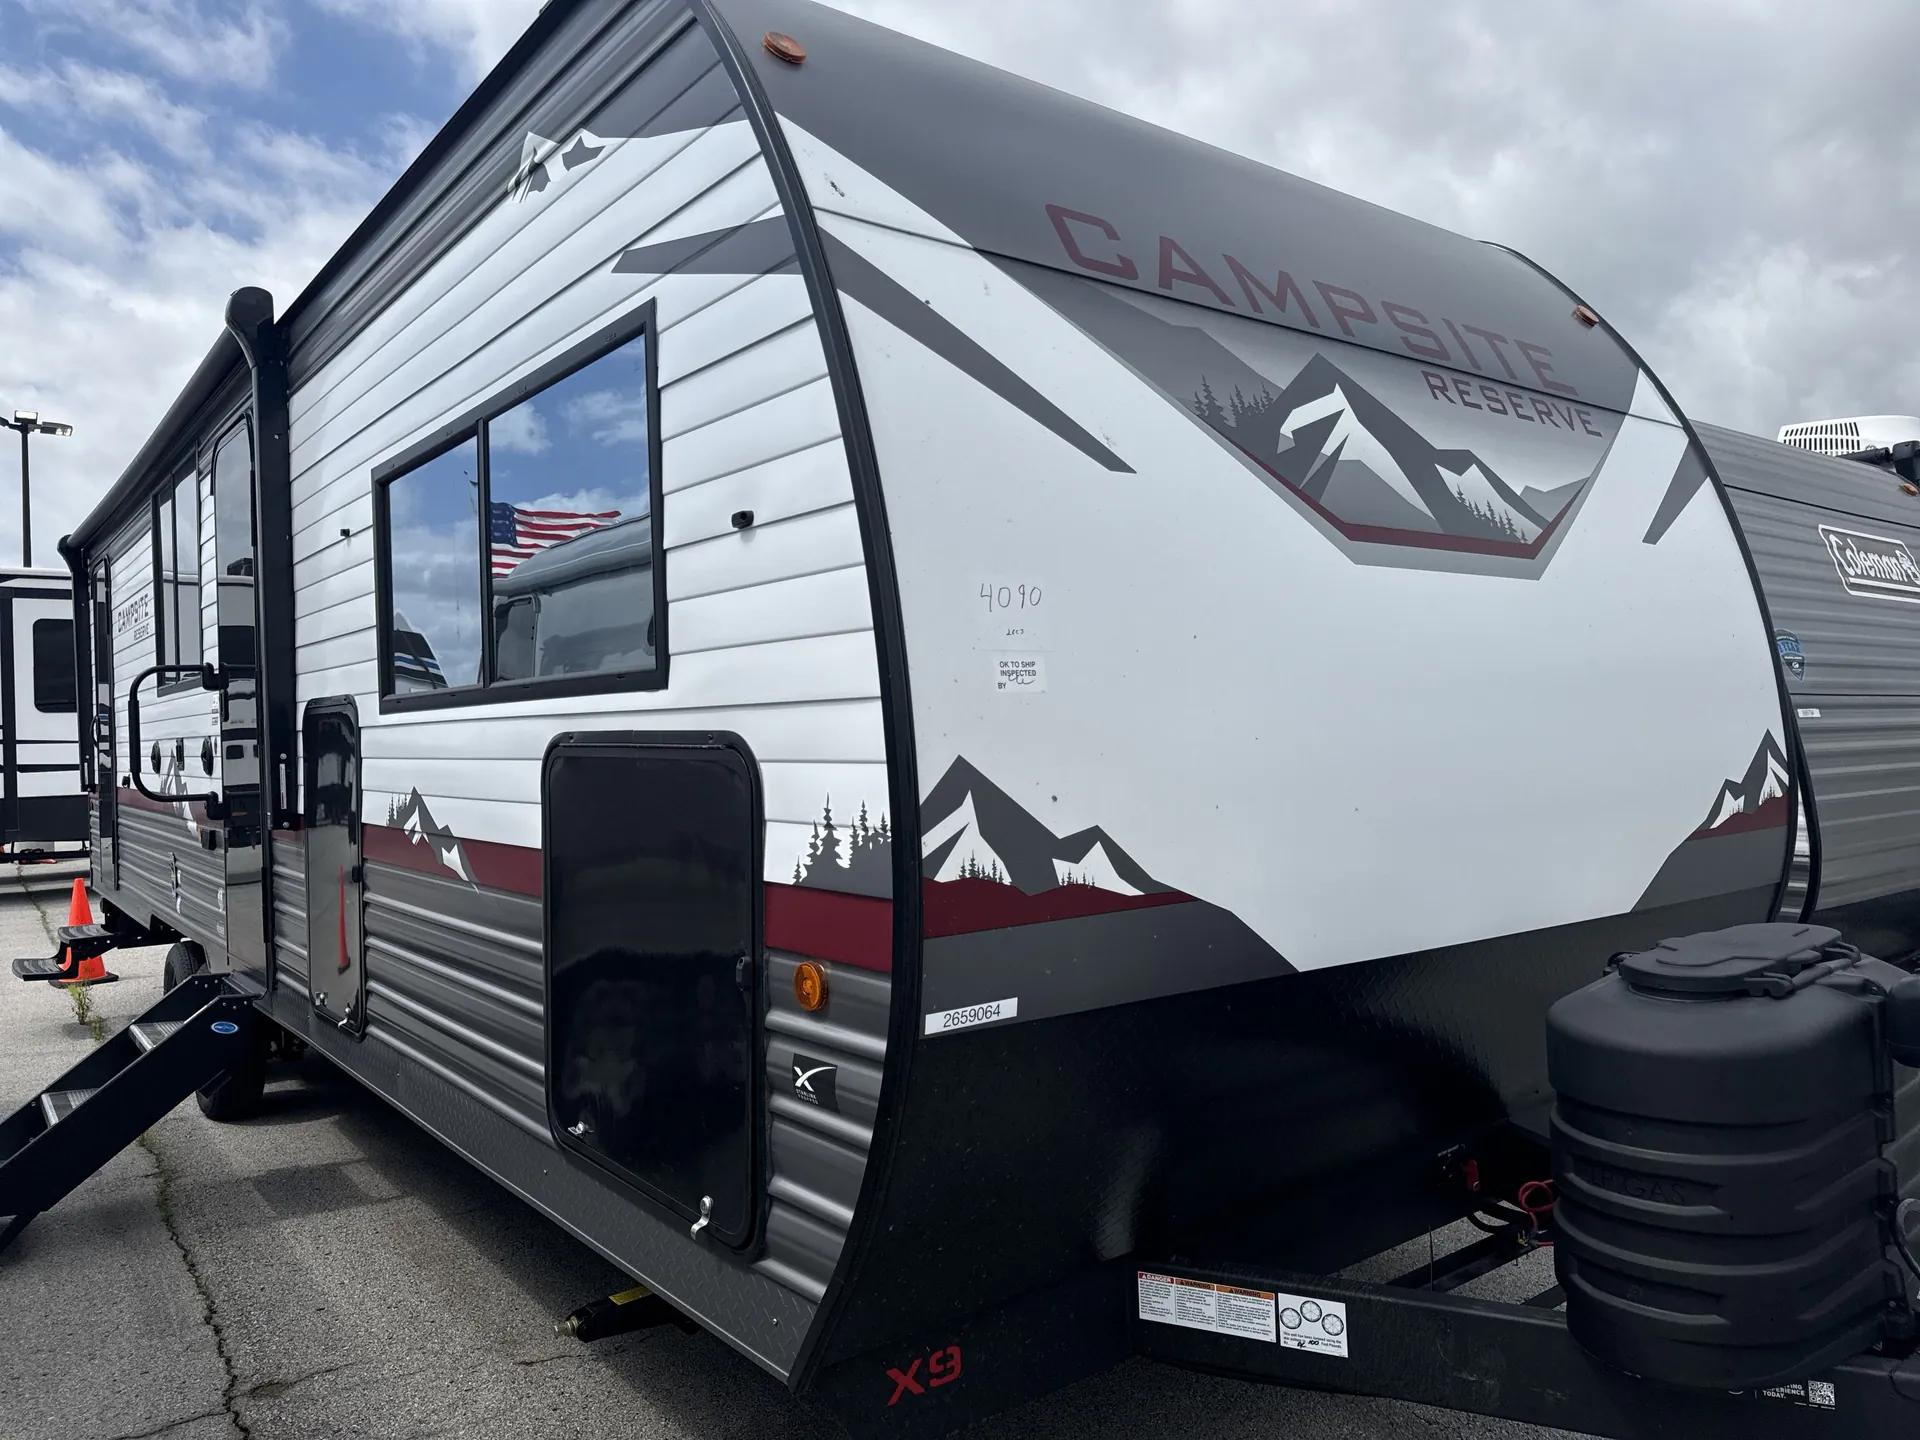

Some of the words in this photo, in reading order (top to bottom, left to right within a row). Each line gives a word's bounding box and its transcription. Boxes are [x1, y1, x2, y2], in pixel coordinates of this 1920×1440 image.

[1045, 203, 1579, 396] CAMPSITE
[1421, 370, 1603, 438] RESERVE
[1829, 534, 1908, 582] Coleman
[980, 583, 1042, 612] 4090
[118, 593, 148, 633] CAMPSITE
[133, 623, 150, 641] RESERVE
[1000, 669, 1037, 677] INSPECTED
[997, 682, 1007, 690] BY
[943, 1003, 1001, 1028] 2659064
[1623, 1174, 1686, 1206] GAS
[1147, 1274, 1172, 1283] DANGER
[1182, 1280, 1211, 1290] WARNING
[1232, 1288, 1261, 1298] WARNING
